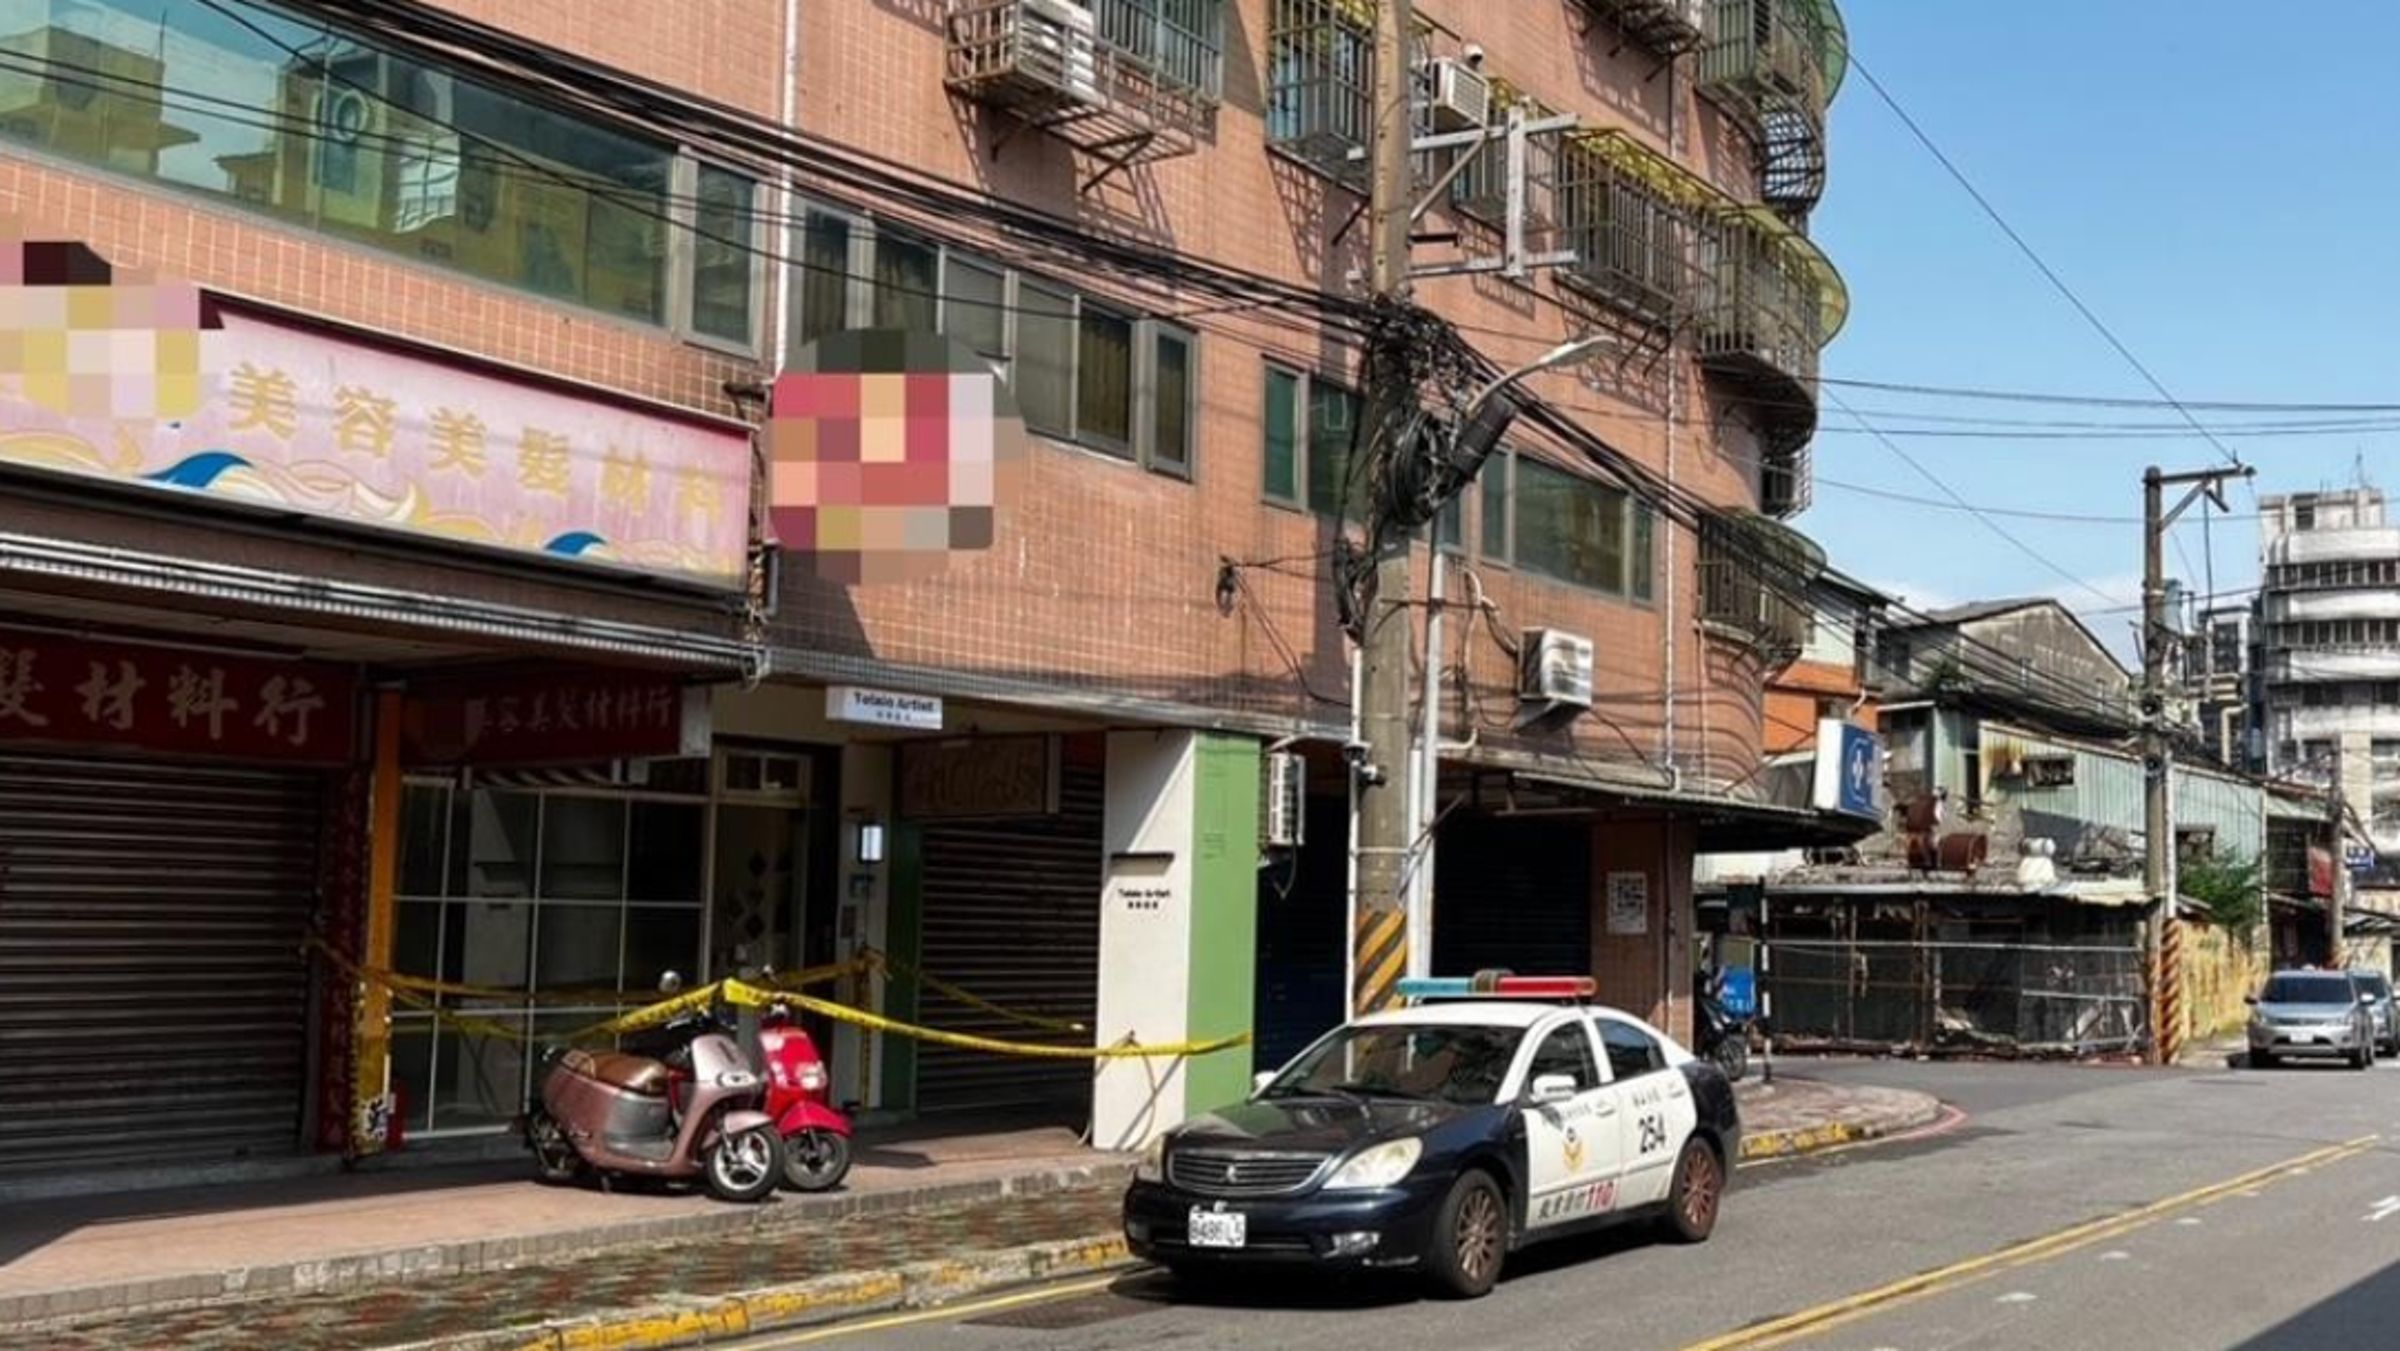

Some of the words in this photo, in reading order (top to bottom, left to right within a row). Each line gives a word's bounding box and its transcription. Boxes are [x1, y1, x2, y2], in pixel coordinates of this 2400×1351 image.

[229, 360, 723, 523] 美容美髮材料
[1638, 1114, 1665, 1154] 254
